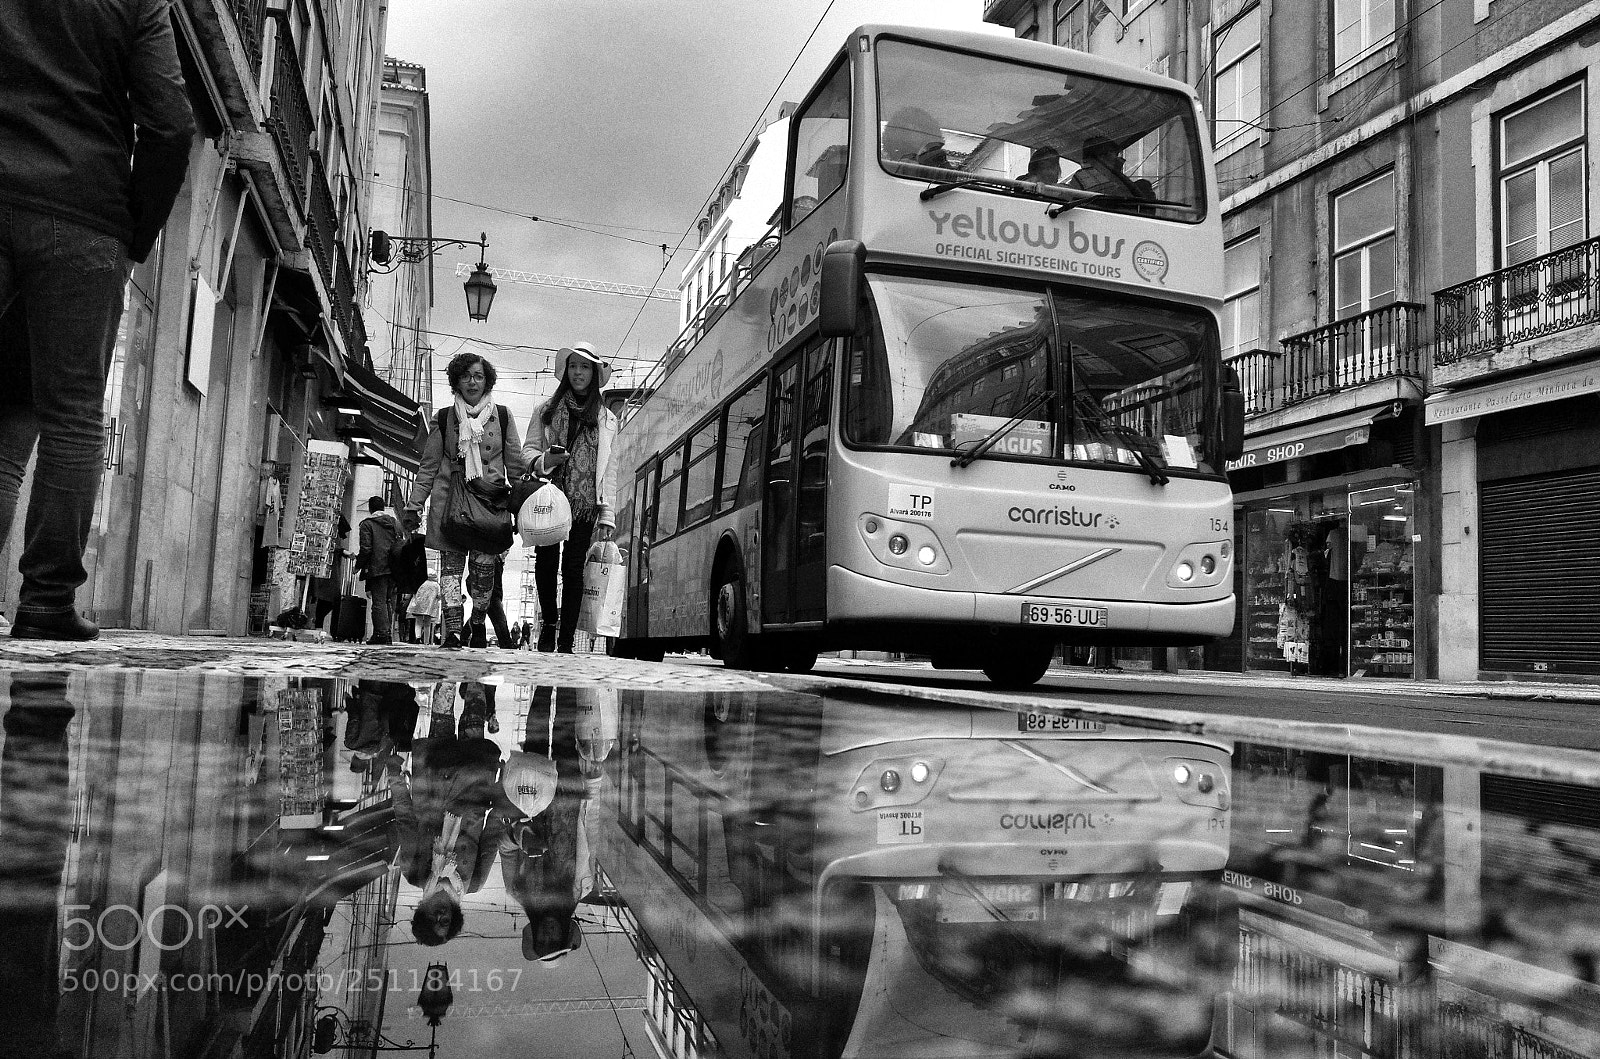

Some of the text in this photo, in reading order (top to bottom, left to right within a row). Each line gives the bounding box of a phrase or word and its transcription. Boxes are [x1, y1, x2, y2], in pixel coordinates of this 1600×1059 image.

[928, 206, 1126, 260] Yellow bus
[935, 242, 1122, 279] OFFICIAL SIGHTSEEING TOURS
[1267, 442, 1305, 462] SHOP
[1049, 483, 1076, 492] CAMO
[909, 494, 932, 509] TP
[1008, 505, 1102, 528] carristur
[1210, 518, 1229, 533] 154
